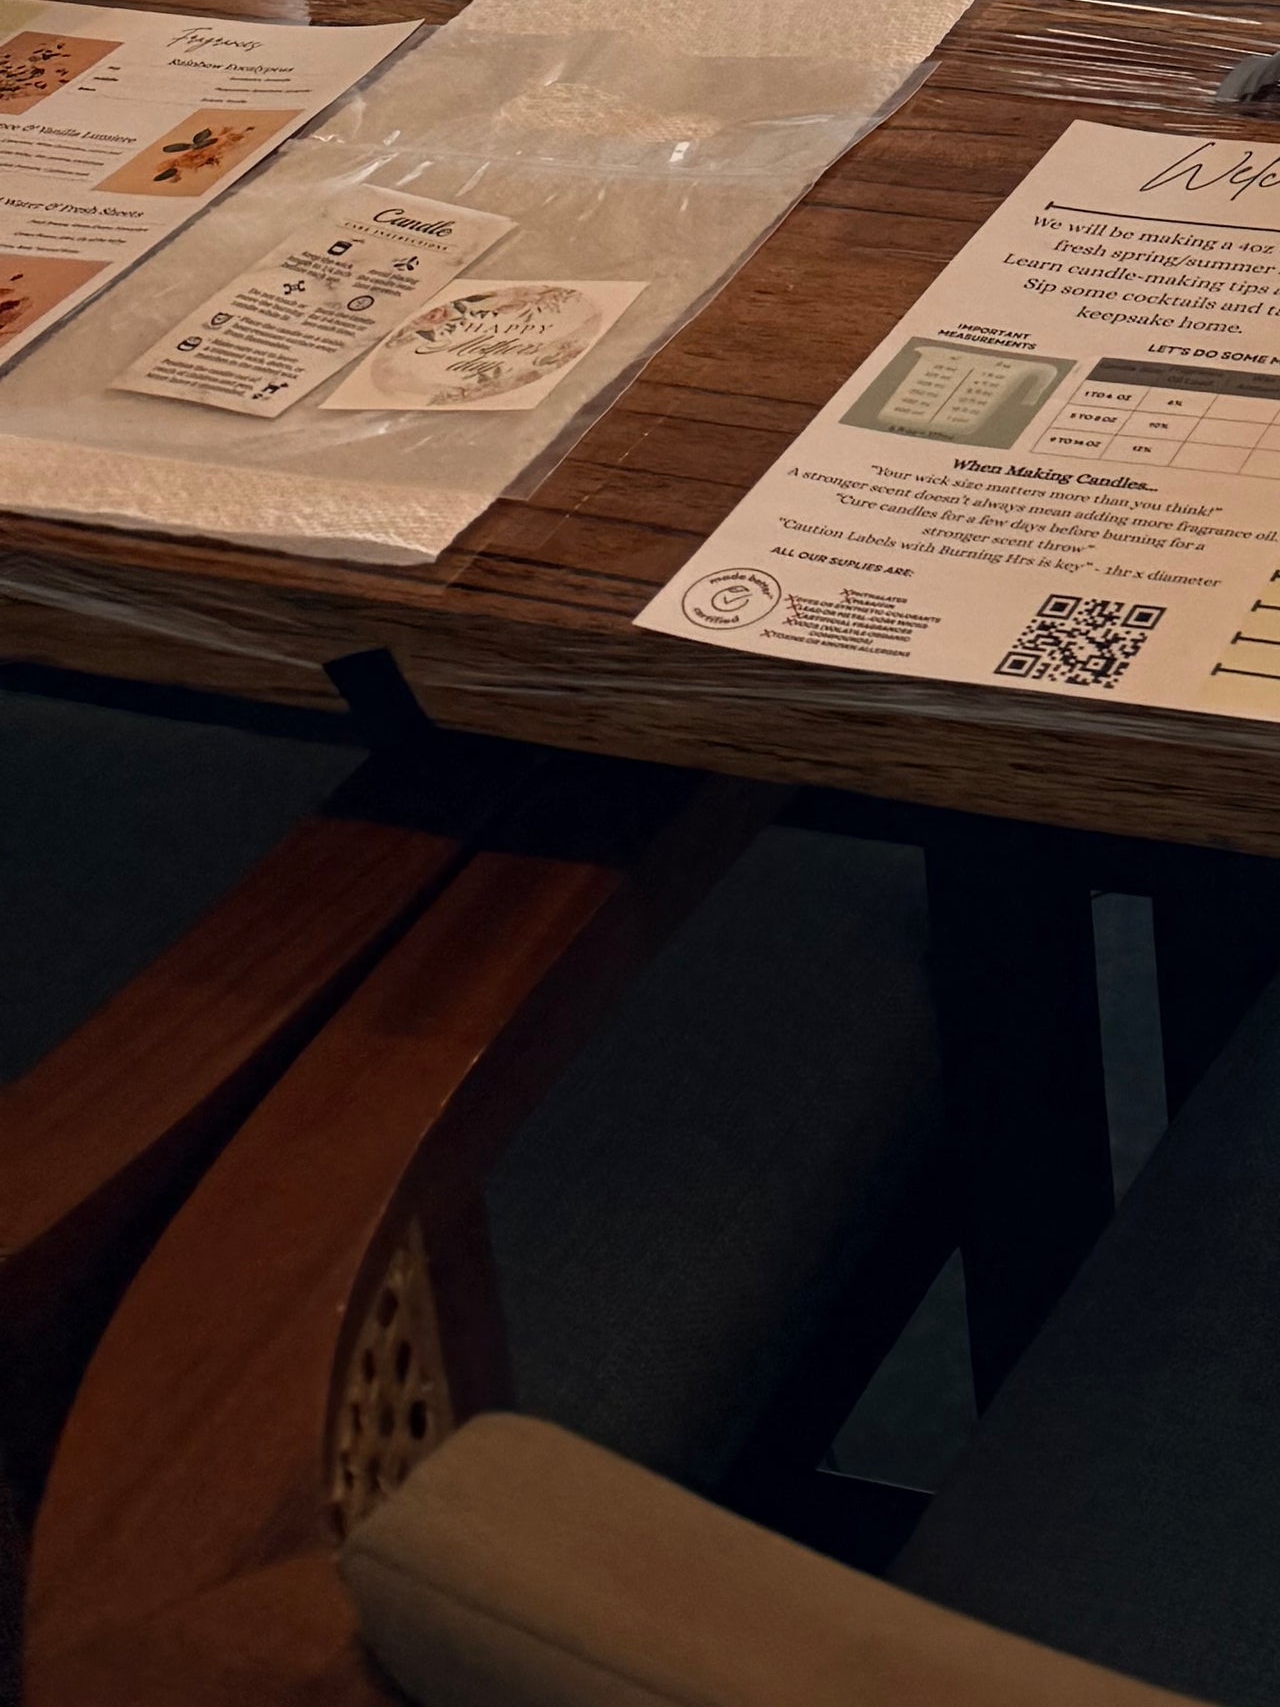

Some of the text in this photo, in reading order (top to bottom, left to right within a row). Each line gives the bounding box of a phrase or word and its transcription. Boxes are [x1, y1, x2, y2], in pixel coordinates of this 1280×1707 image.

[373, 207, 456, 239] Candle
[1033, 214, 1063, 230] We
[1068, 222, 1108, 237] will
[1107, 225, 1135, 240] be
[1137, 231, 1219, 252] making
[1219, 240, 1234, 251] a
[1237, 241, 1275, 255] 4oz
[1052, 238, 1107, 257] fresh
[1109, 249, 1276, 275] spring/summer
[1001, 252, 1063, 273] Learn
[1066, 264, 1226, 293] candle-making
[1227, 279, 1270, 296] tips
[1022, 277, 1057, 295] Sip
[1059, 284, 1118, 300] some
[1121, 291, 1217, 310] cocktails
[1219, 301, 1264, 315] and
[464, 322, 556, 335] HAPPY
[957, 323, 1032, 341] IMPORTANT
[1075, 304, 1243, 334] keepsake home.
[938, 329, 1038, 351] MEASUREMENTS
[1191, 347, 1219, 359] DO
[1219, 350, 1269, 364] SOME
[952, 457, 1003, 475] When
[1003, 463, 1074, 486] Making
[786, 466, 799, 477] A
[800, 470, 870, 490] stronger
[868, 484, 912, 498] scent
[970, 496, 1027, 514] always
[1026, 505, 1072, 518] mean
[1072, 509, 1130, 527] adding
[1130, 517, 1174, 530] more
[1175, 519, 1253, 539] fragrance
[914, 473, 951, 487] wick
[950, 477, 984, 491] size
[984, 483, 1047, 498] matters
[1047, 490, 1091, 503] more
[1092, 492, 1130, 507] than
[1128, 499, 1162, 511] you
[769, 545, 795, 558] ALL
[796, 550, 828, 563] OUR
[827, 556, 884, 573] SUPLIES
